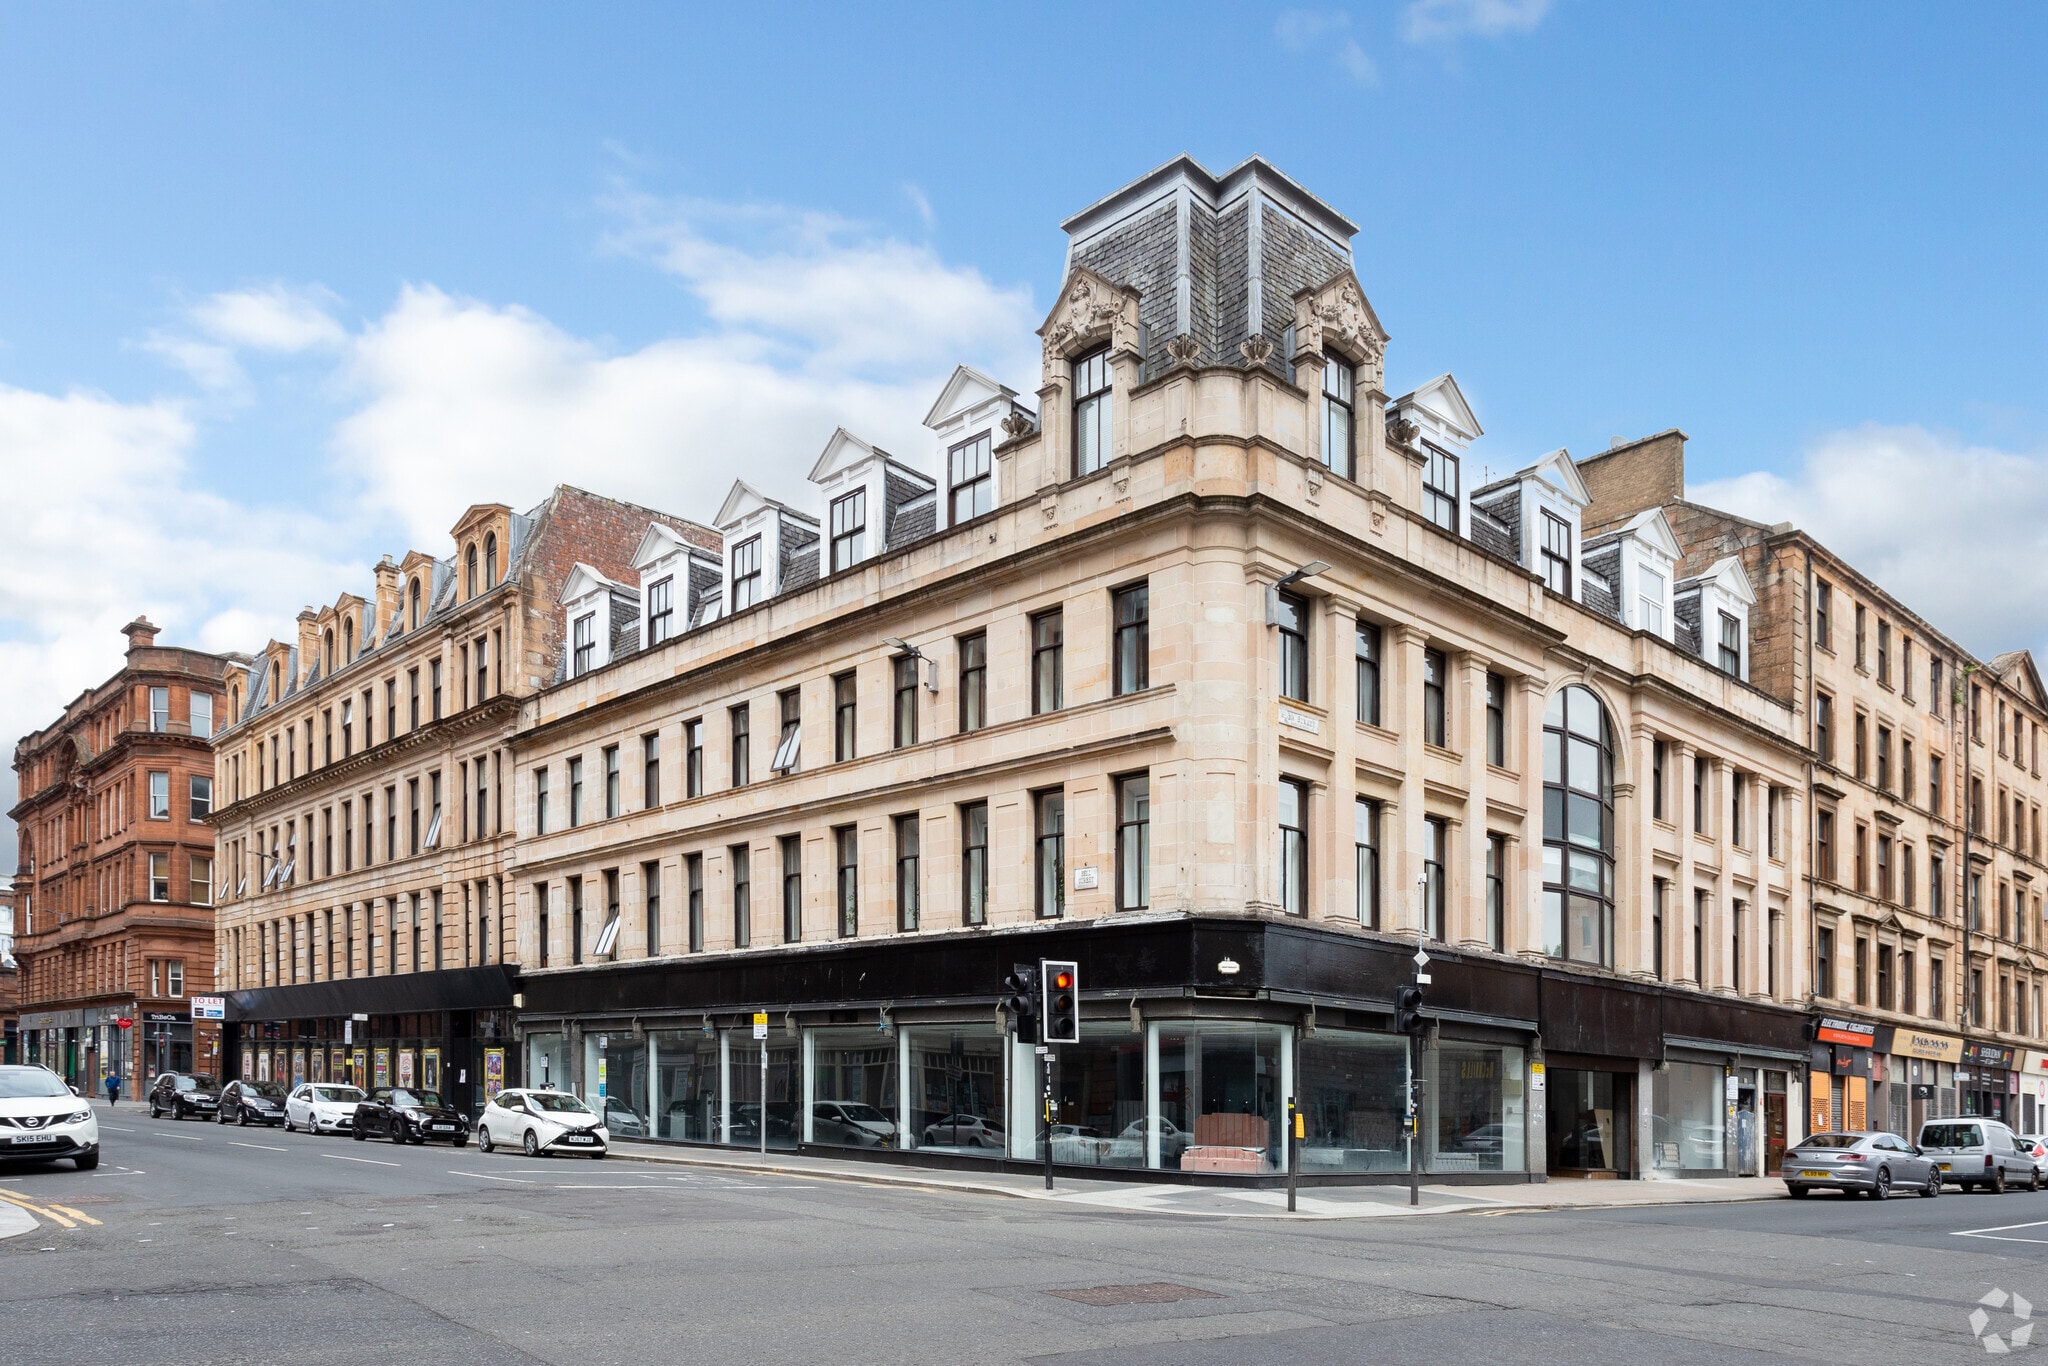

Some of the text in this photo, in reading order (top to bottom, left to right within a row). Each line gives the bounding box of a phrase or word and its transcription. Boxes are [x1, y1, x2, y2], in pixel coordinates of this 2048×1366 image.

[1821, 1018, 1875, 1034] ELECTRONIC CIGARETTES
[16, 1133, 52, 1143] SK15 EHU
